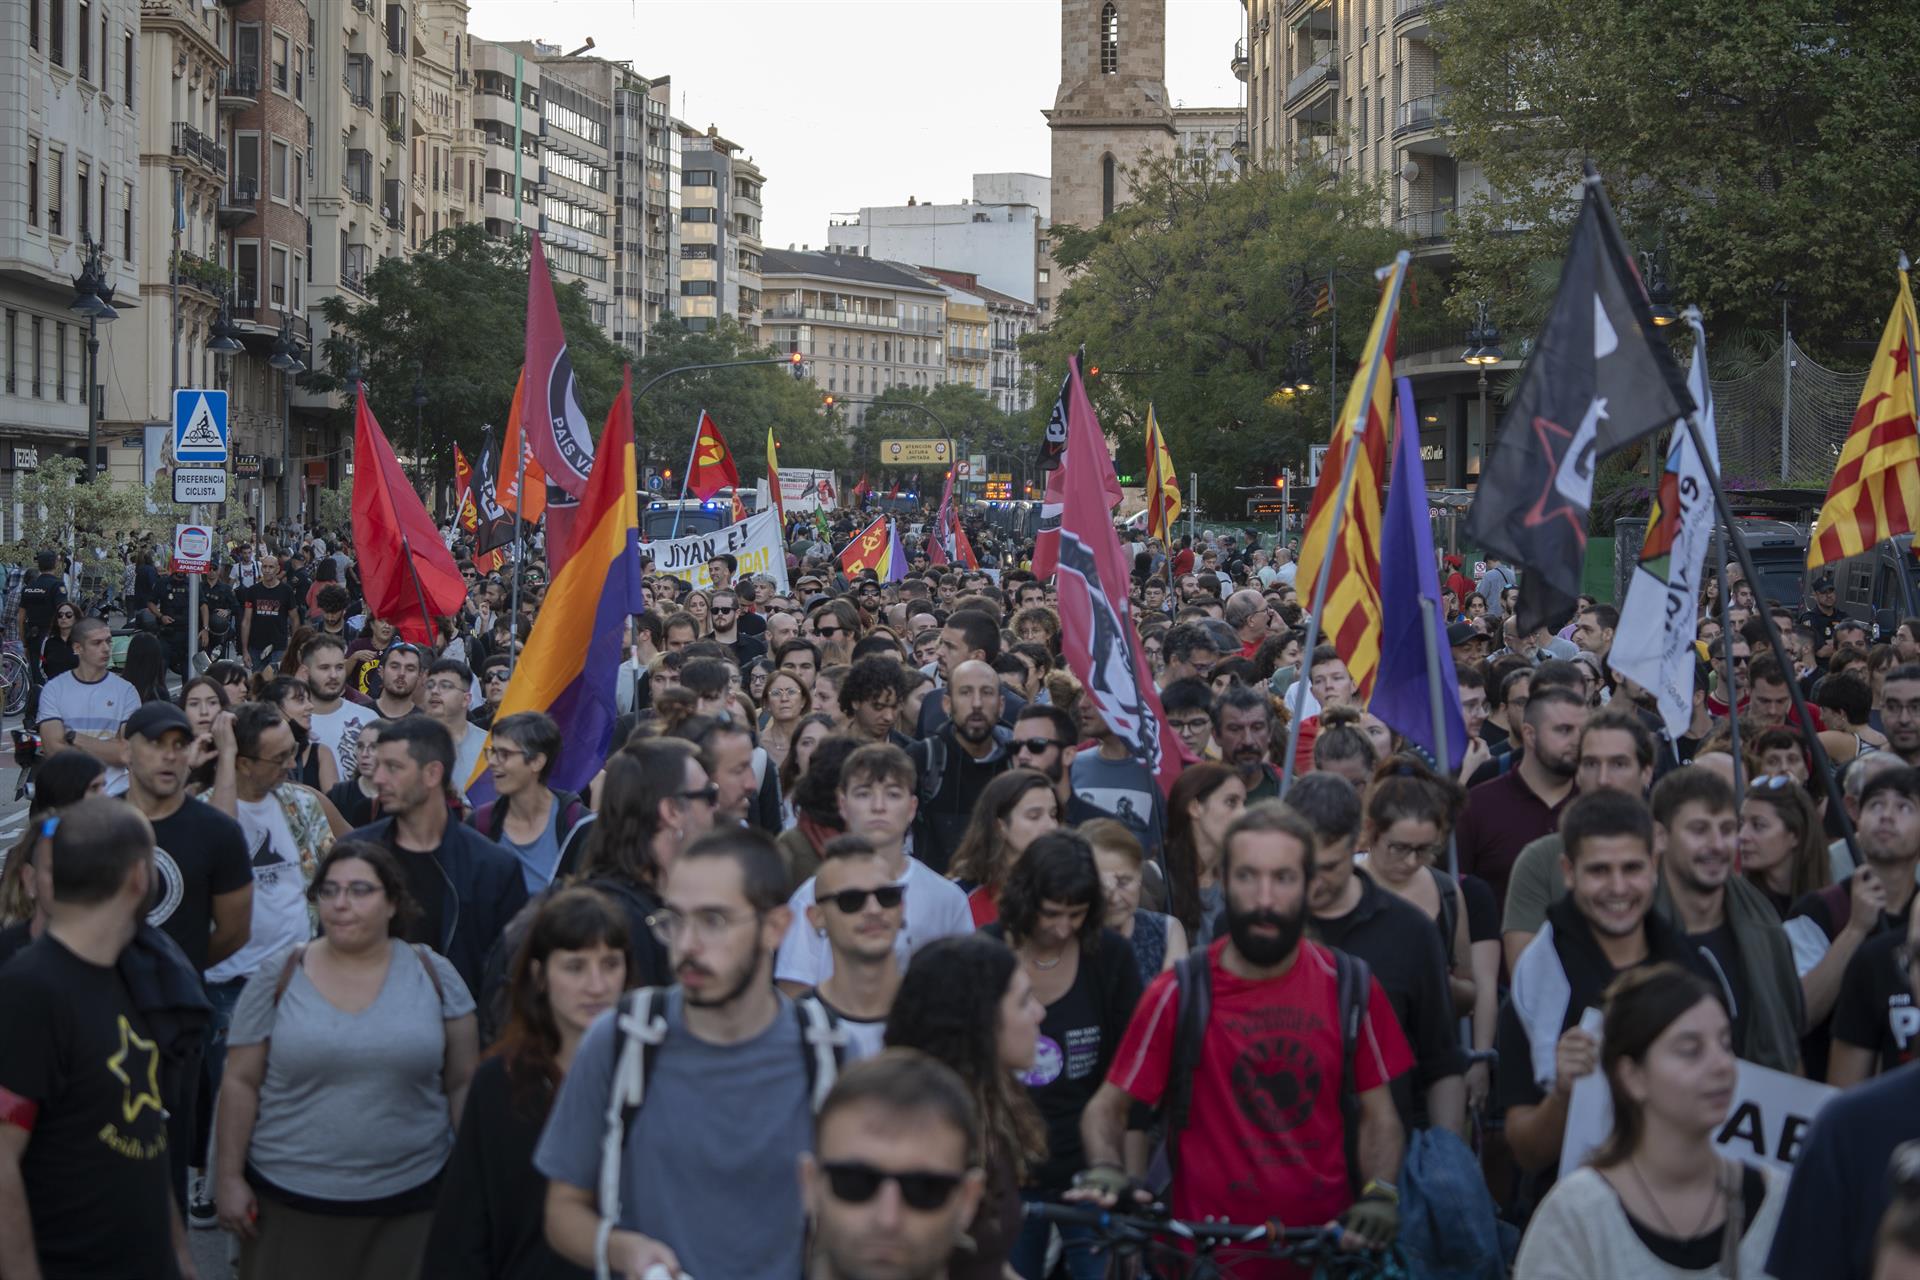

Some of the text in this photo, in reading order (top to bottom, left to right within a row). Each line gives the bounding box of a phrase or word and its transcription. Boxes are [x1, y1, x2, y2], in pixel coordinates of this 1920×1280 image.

[553, 418, 576, 456] PAÍS
[177, 475, 225, 484] PREFERENCIA
[185, 487, 217, 496] CICLISTA
[664, 539, 715, 568] JÎYAN
[728, 523, 748, 552] E!
